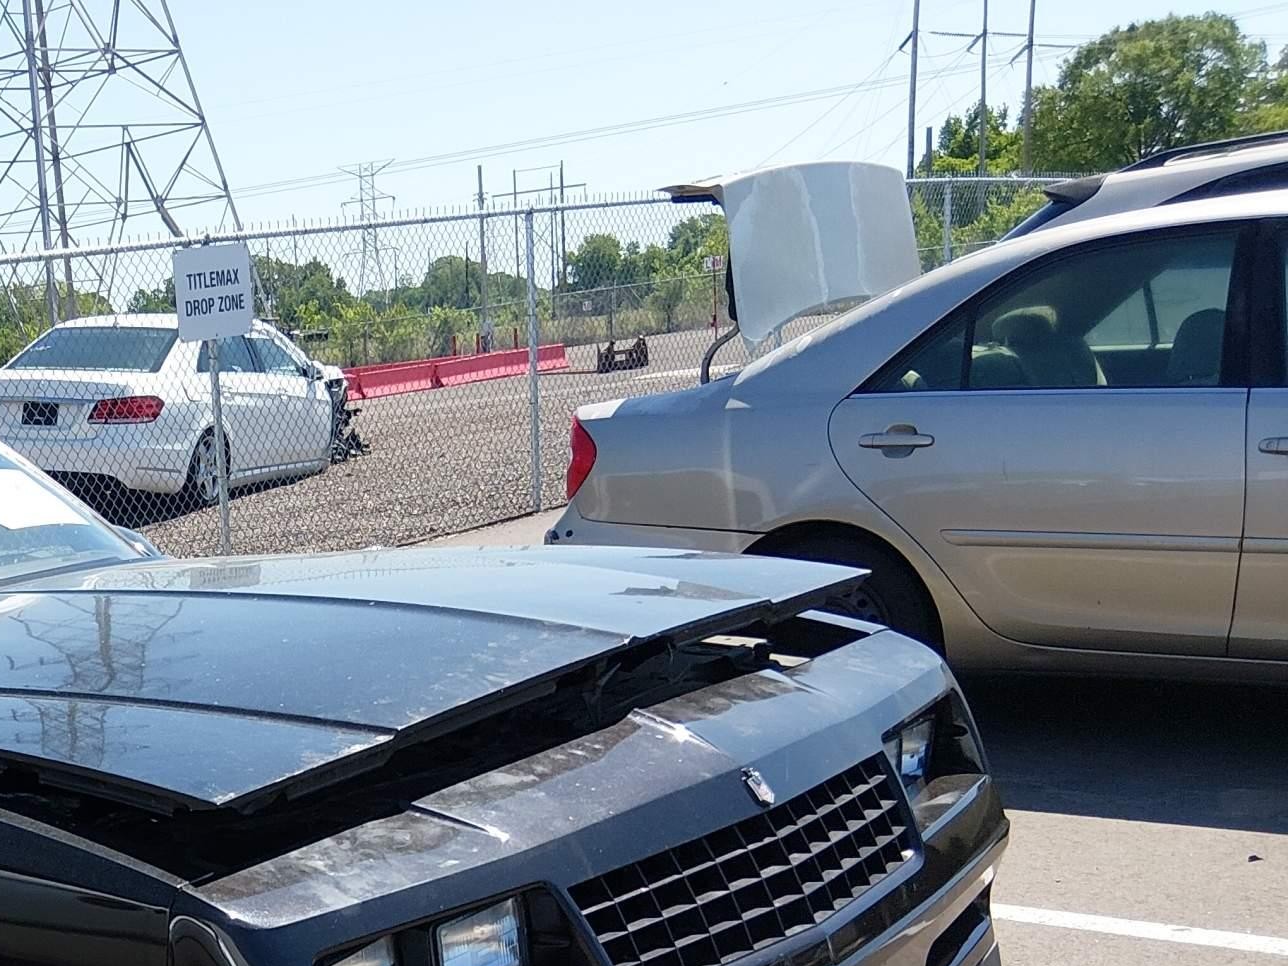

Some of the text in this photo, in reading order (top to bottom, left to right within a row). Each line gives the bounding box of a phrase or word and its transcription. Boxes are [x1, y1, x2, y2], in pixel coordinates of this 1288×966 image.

[186, 268, 240, 290] TITLEMAX
[185, 294, 245, 317] DROP ZONE
